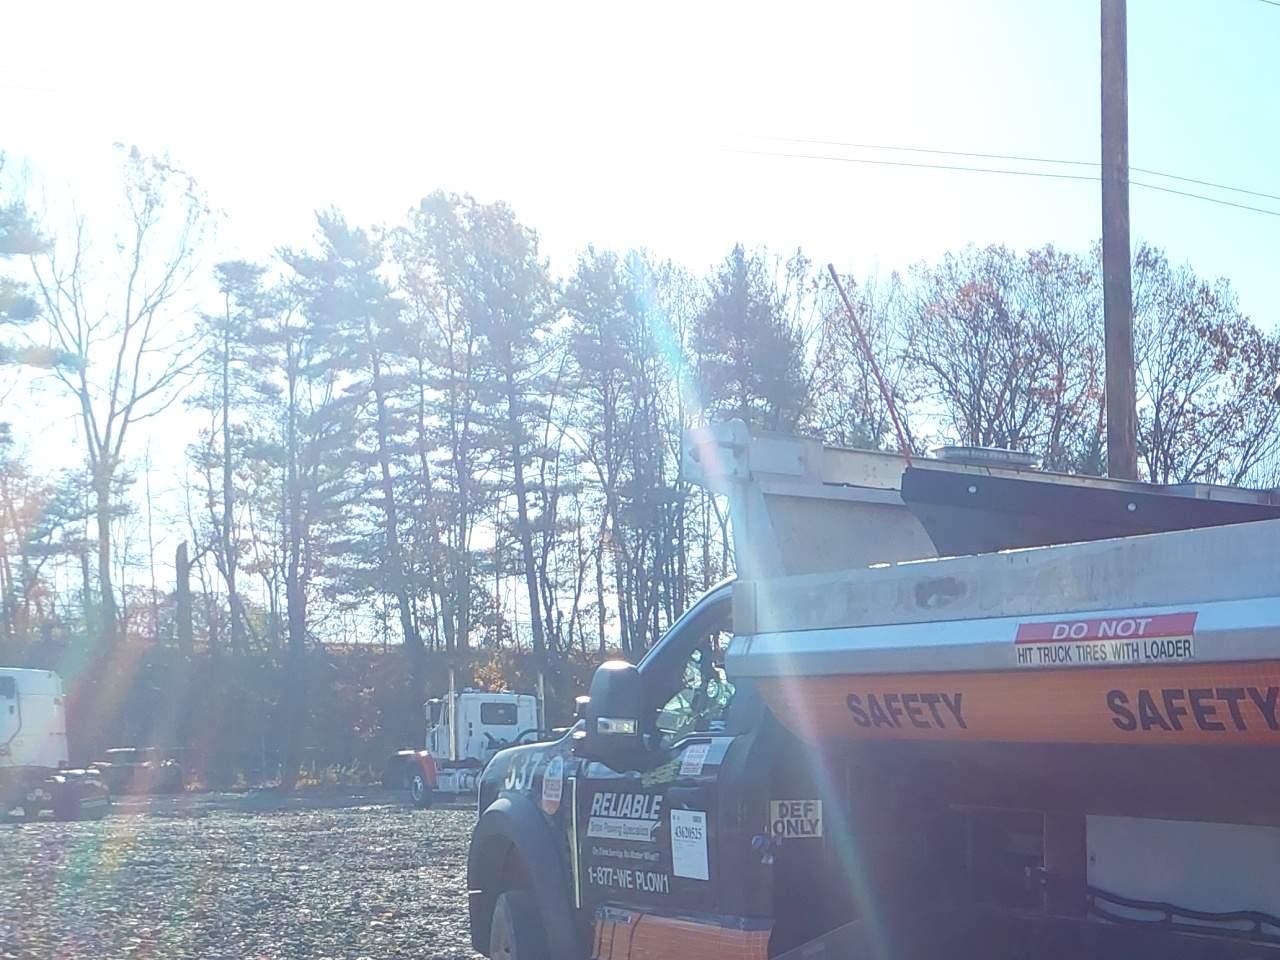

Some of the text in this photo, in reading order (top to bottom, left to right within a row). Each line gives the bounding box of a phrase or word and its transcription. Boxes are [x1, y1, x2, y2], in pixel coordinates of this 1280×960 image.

[1053, 618, 1152, 639] DO NOT
[1017, 639, 1192, 664] HIT TRUCK TIRES WITH LOADER
[846, 693, 967, 729] SAFETY
[1106, 686, 1280, 732] SAFETY
[591, 793, 663, 819] RELIABLE
[778, 803, 815, 818] DEF
[773, 818, 820, 836] ONLY
[588, 866, 670, 894] 1-877-WE PLOW1
